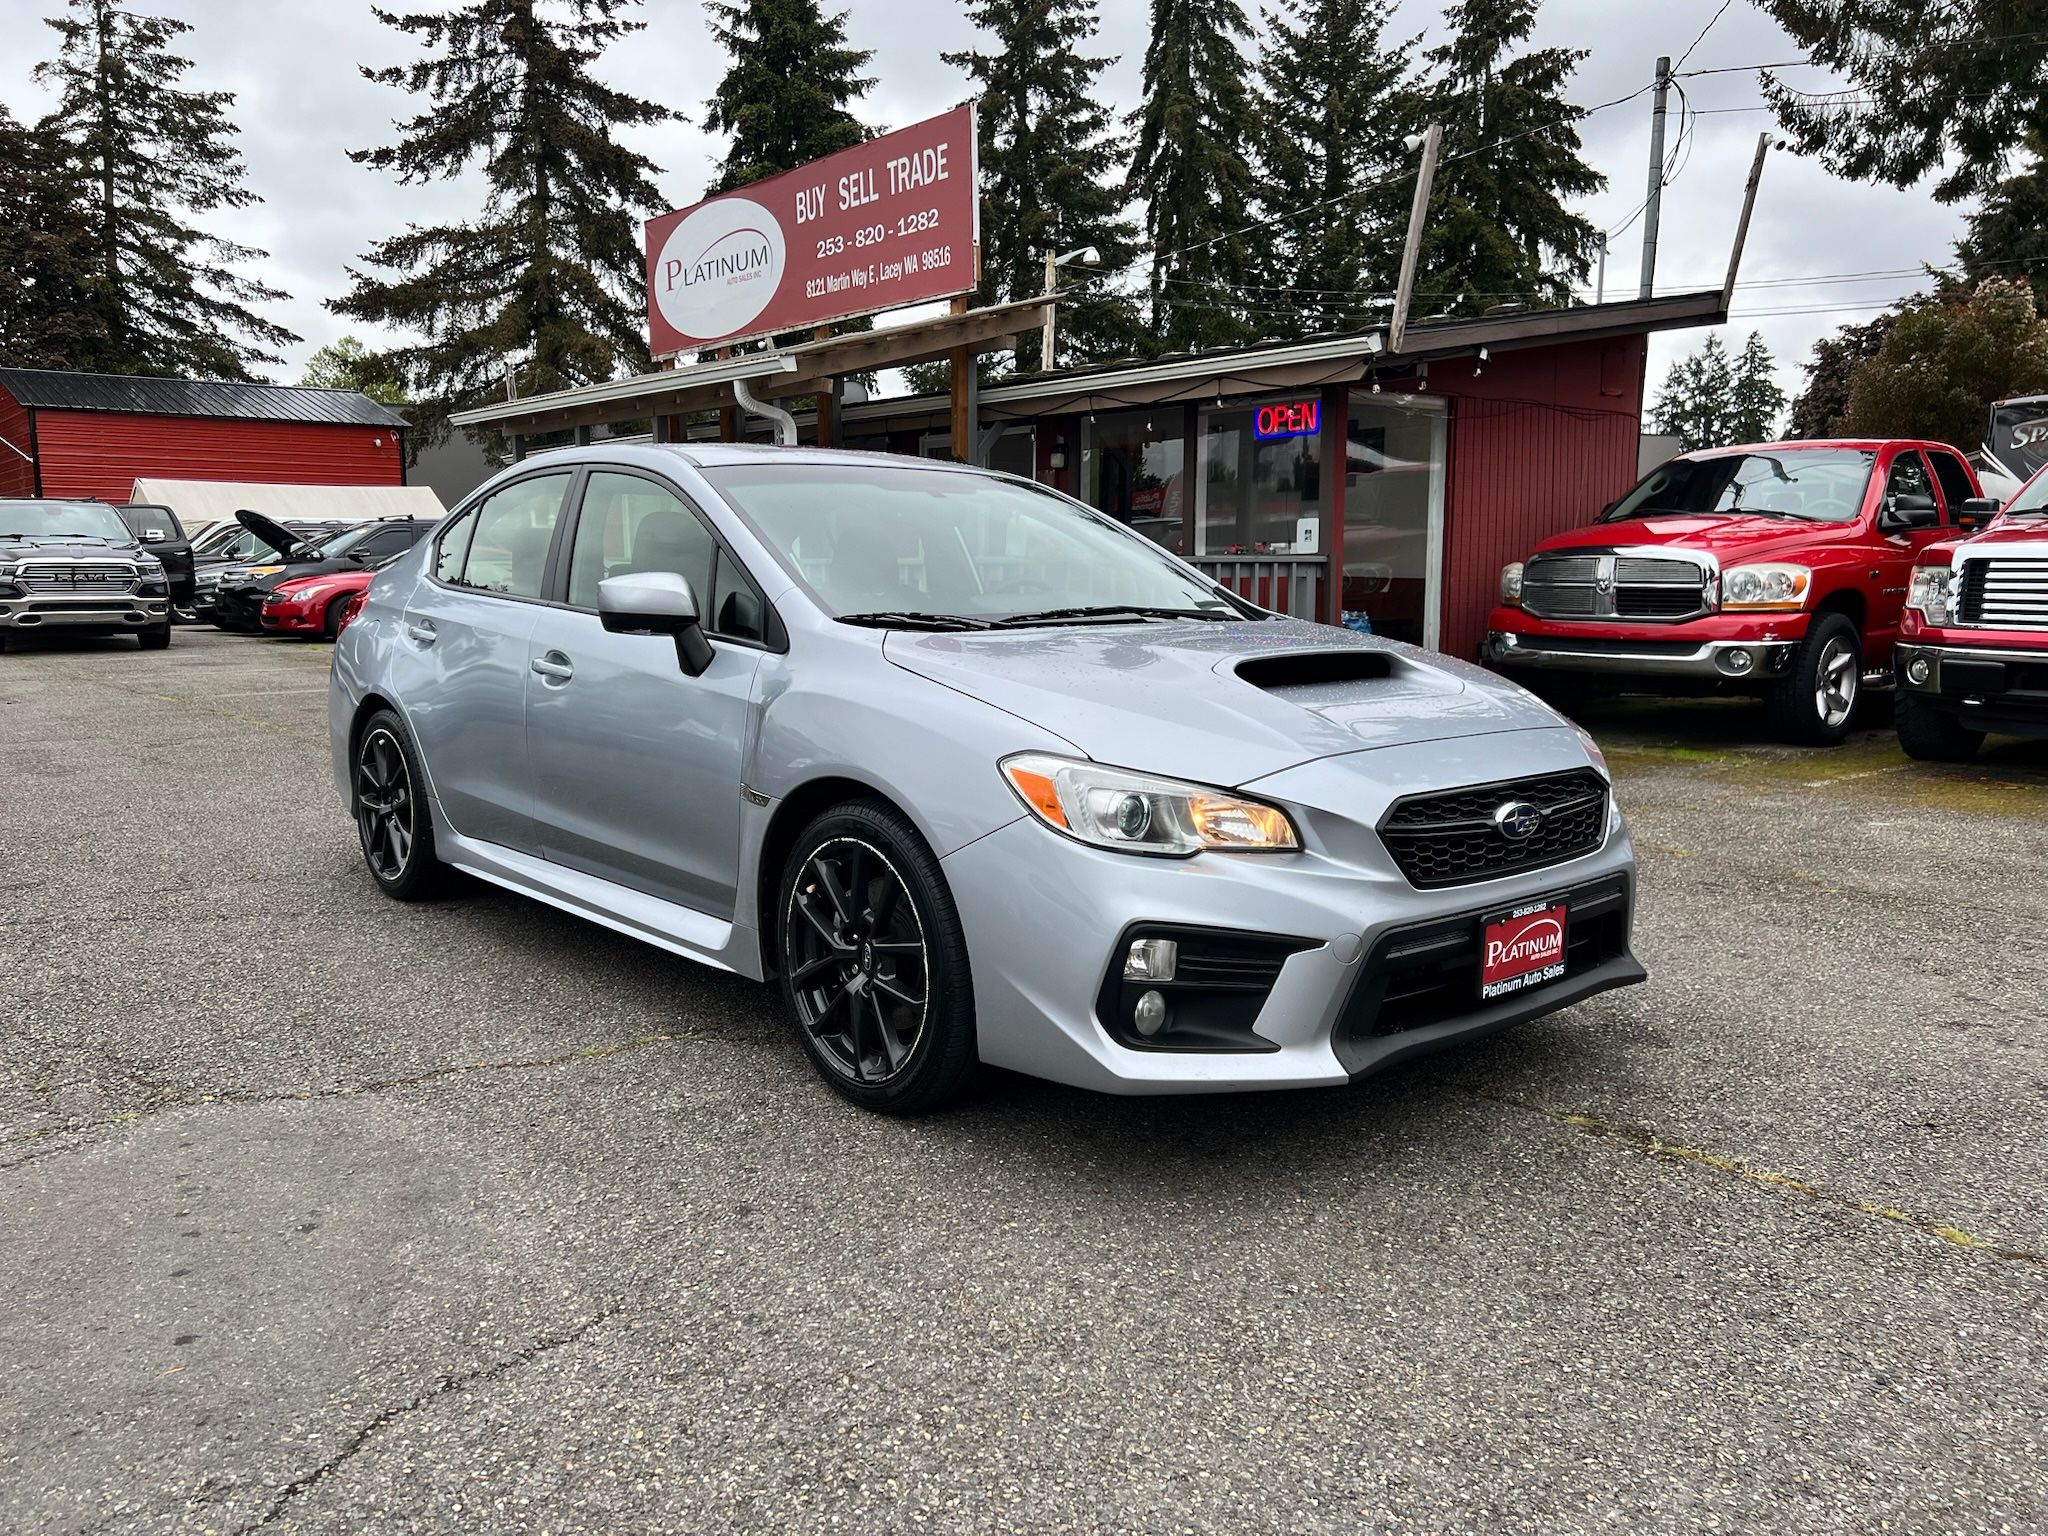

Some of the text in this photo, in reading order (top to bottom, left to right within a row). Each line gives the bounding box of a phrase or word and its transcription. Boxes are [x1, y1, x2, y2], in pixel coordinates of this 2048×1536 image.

[795, 143, 949, 224] BUY SELL TRADE
[816, 235, 845, 259] 253
[855, 223, 885, 248] 820
[897, 208, 939, 237] 1282
[664, 244, 769, 293] PLATINUM
[805, 278, 826, 299] 8121
[826, 271, 851, 294] Martin
[851, 265, 868, 289] Way
[880, 259, 902, 282] Lacey
[904, 253, 919, 275] WA
[922, 245, 951, 271] 98516
[1258, 401, 1317, 434] OPEN
[1512, 902, 1547, 919] 253-820-1282
[1486, 932, 1561, 968] PLATINUM
[1482, 964, 1565, 999] Platinum Auto Sales
